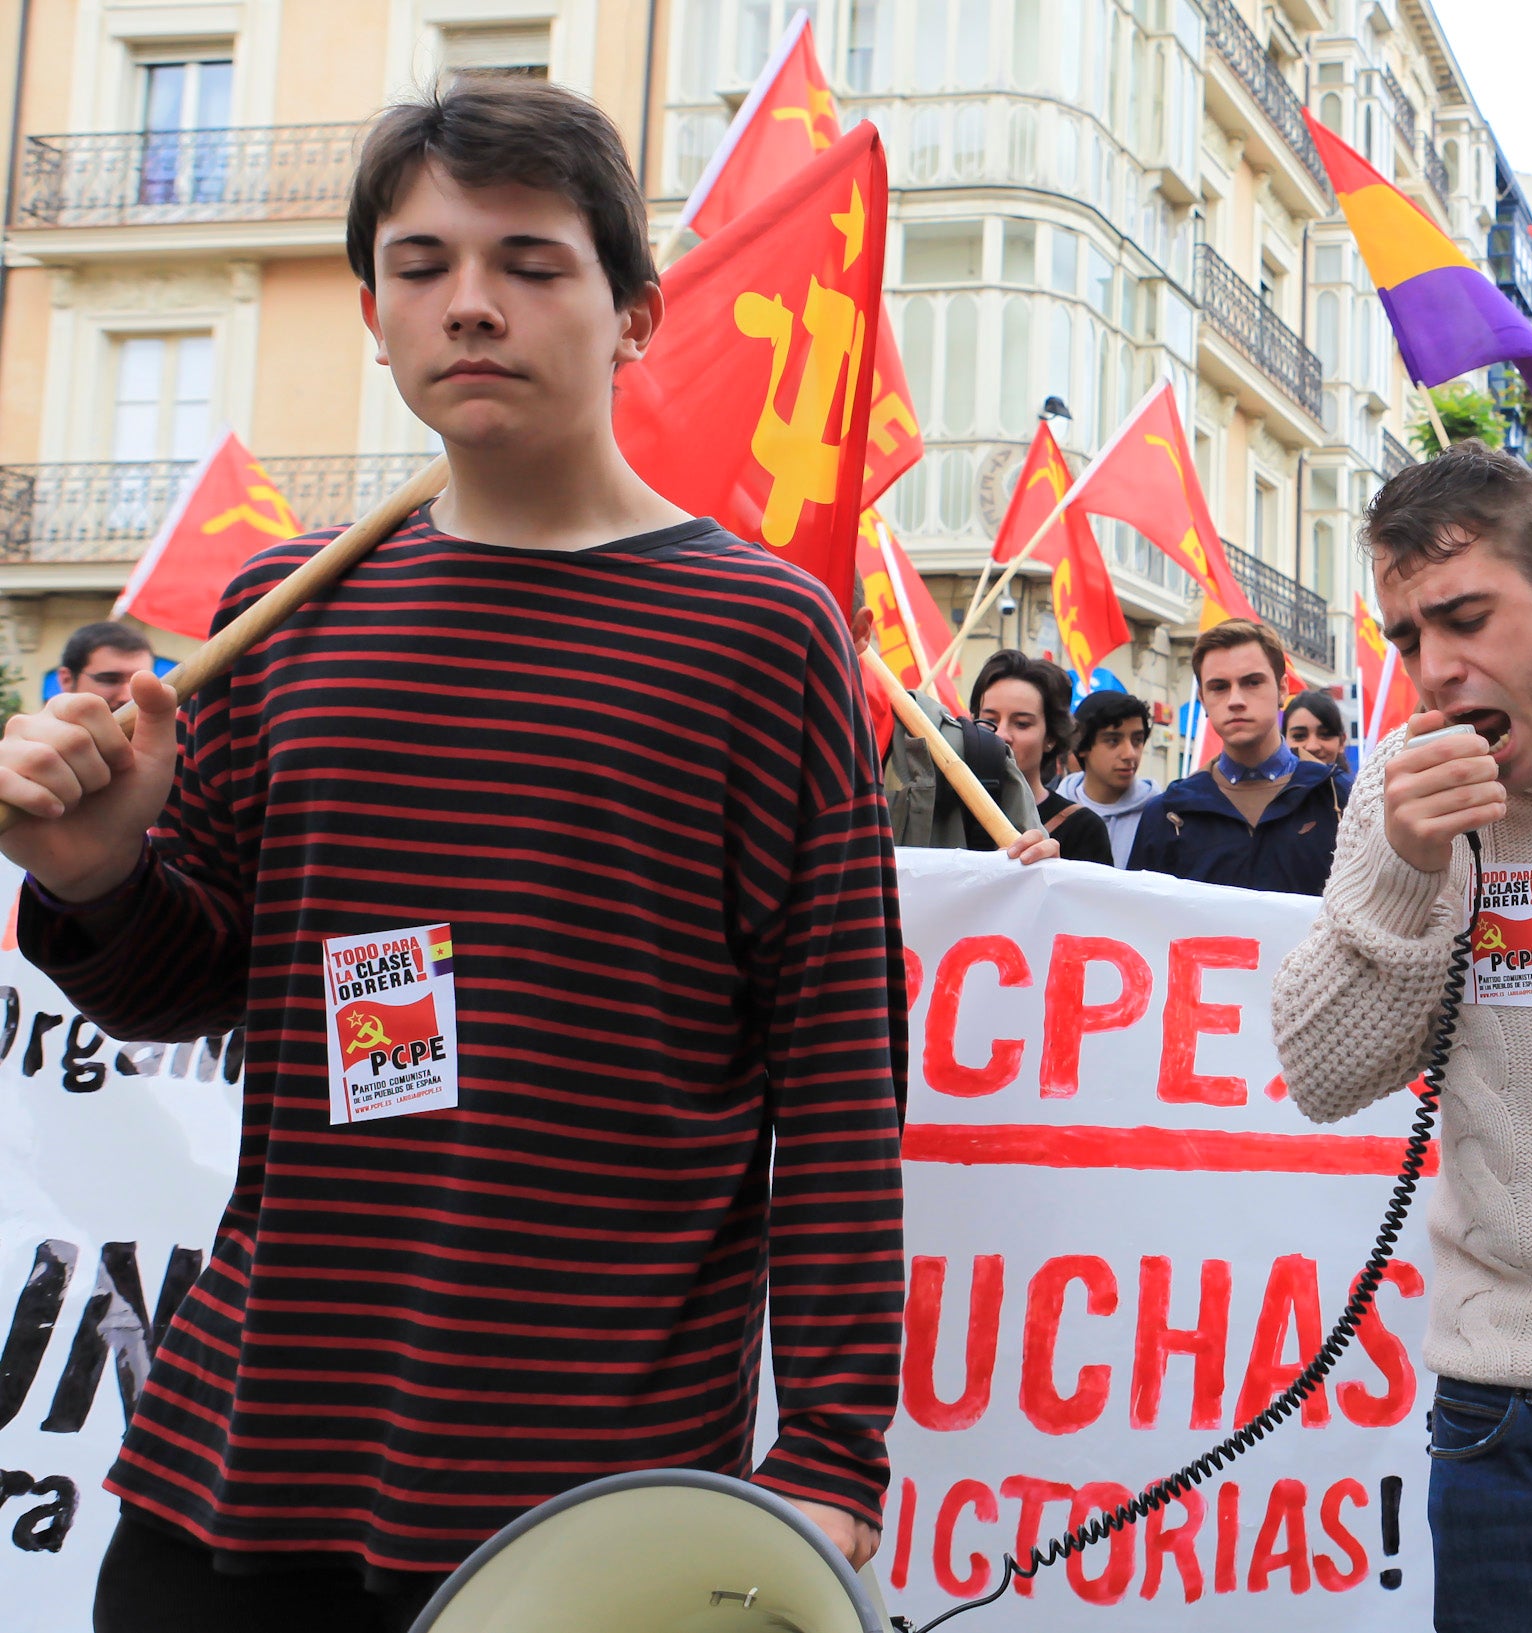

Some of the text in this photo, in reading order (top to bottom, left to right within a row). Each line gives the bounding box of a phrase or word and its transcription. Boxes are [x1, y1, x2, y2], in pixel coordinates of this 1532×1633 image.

[1474, 871, 1507, 884] ODO
[1488, 880, 1530, 896] CLASE
[331, 936, 420, 968] TODO PARA
[335, 951, 412, 984] LA CLASE
[369, 1035, 447, 1076] PCPE
[887, 1252, 1425, 1436] UCHAS
[880, 1473, 1403, 1606] ICTORIAS!
